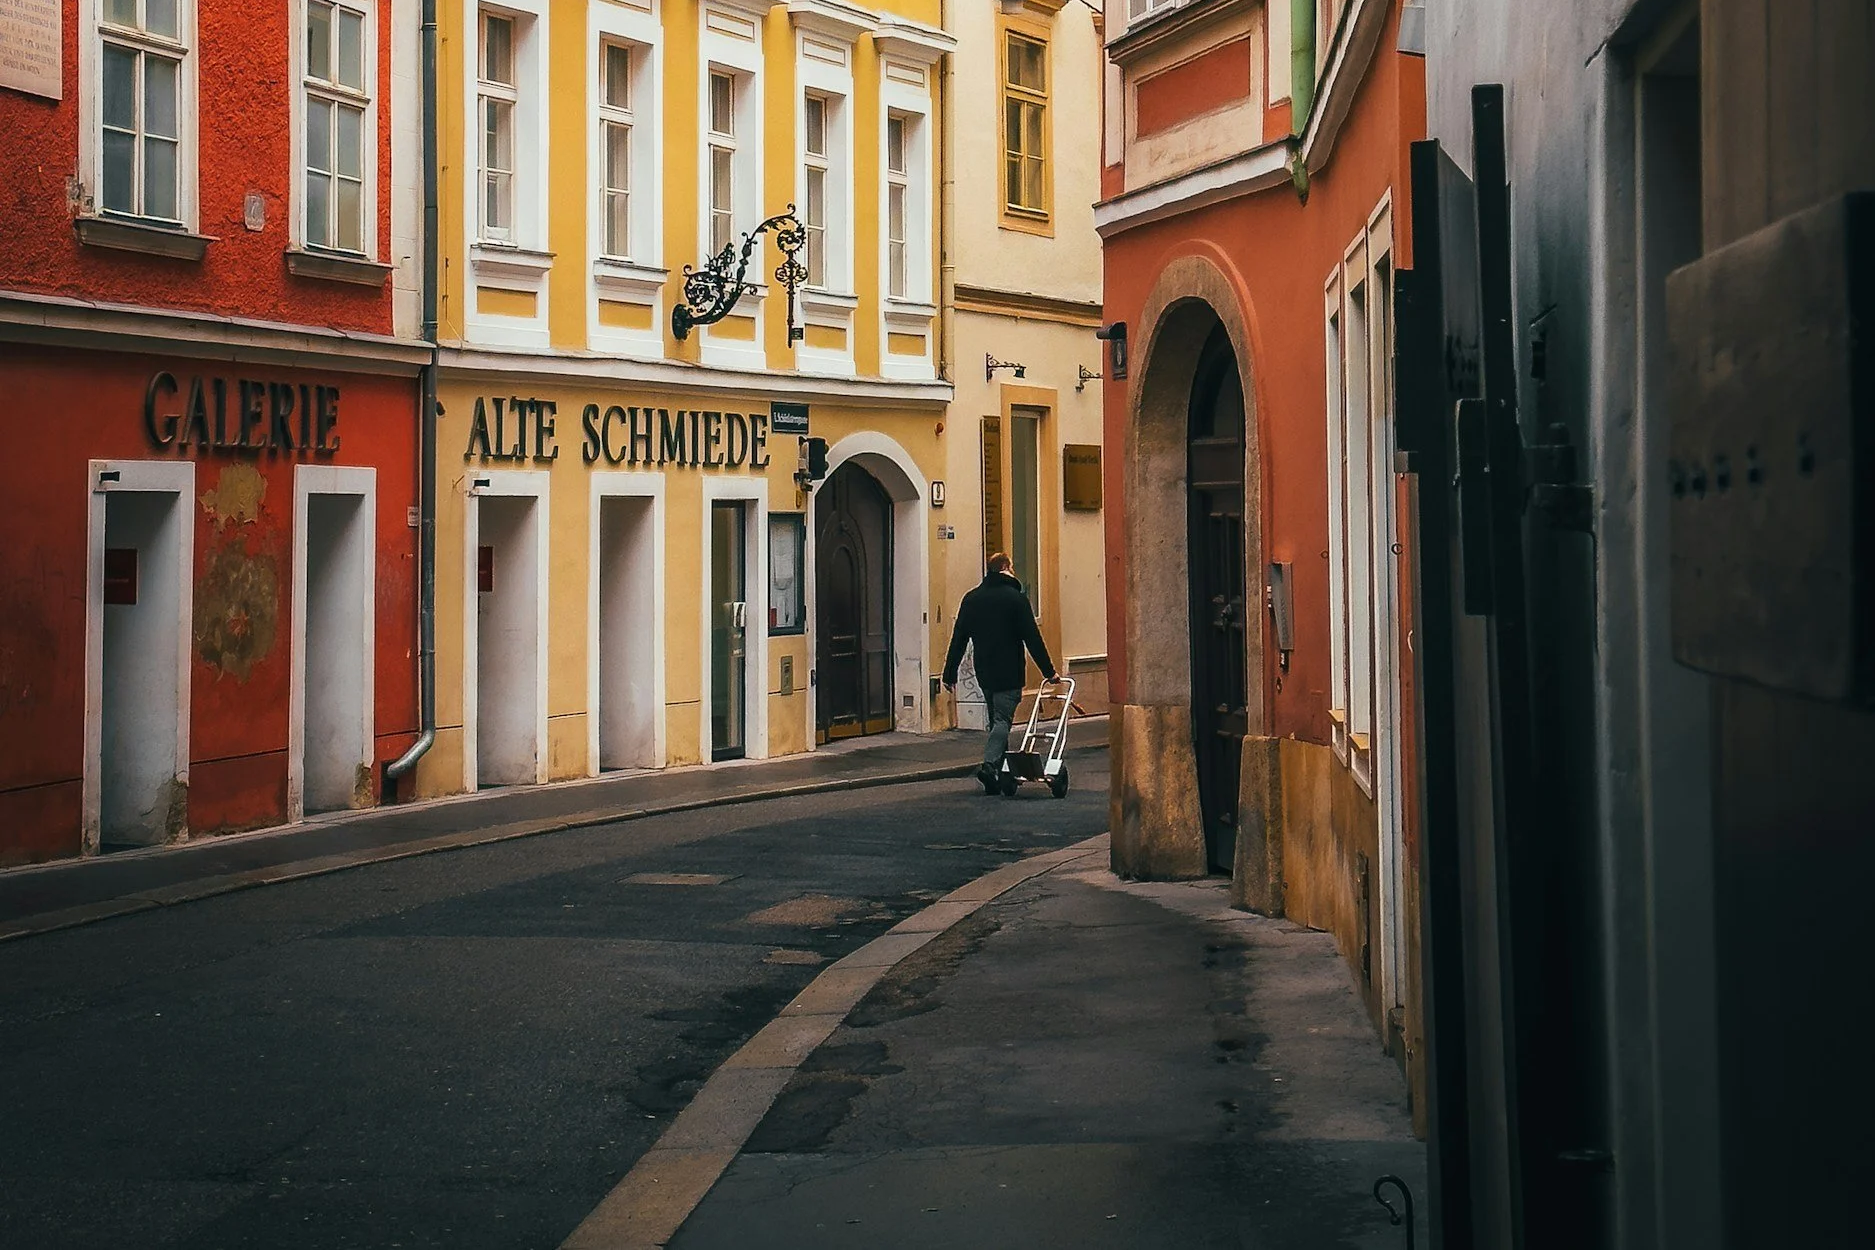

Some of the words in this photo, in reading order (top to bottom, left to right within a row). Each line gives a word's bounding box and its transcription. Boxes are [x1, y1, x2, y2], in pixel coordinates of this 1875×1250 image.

[145, 370, 340, 454] GALERIE
[464, 396, 559, 461] ALTE
[582, 403, 771, 468] SCHMIEDE
